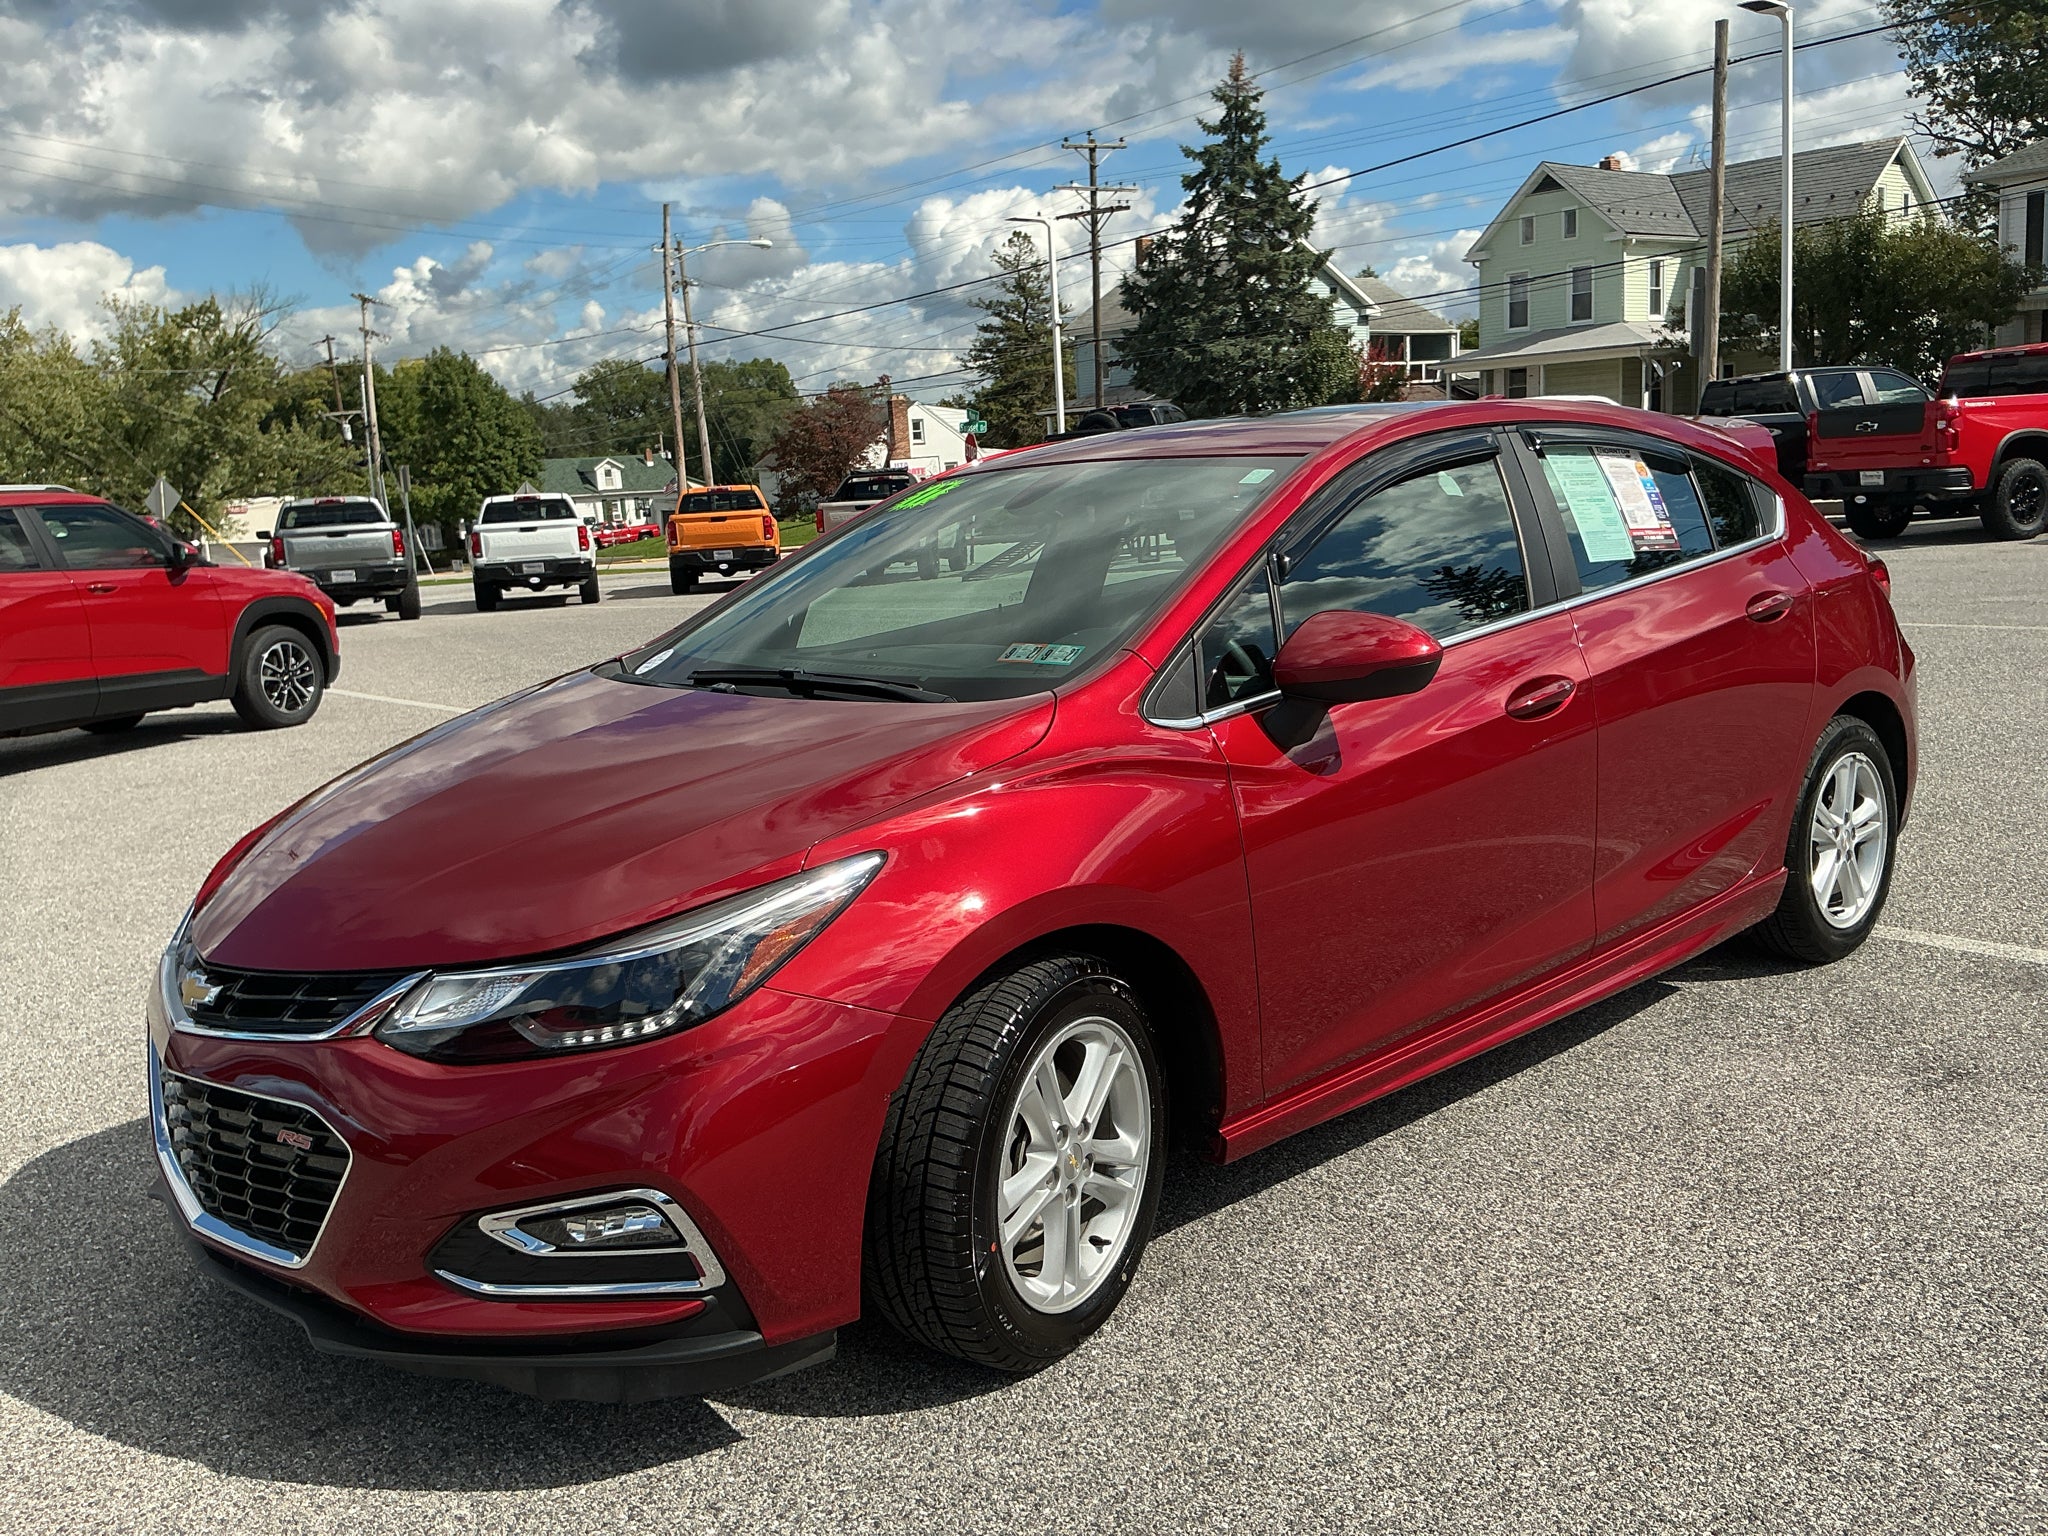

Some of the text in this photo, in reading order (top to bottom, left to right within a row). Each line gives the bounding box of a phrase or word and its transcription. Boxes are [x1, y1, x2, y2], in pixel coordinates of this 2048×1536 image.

[1004, 647, 1018, 659] 9
[1041, 649, 1054, 661] 9
[276, 1129, 313, 1150] RS
